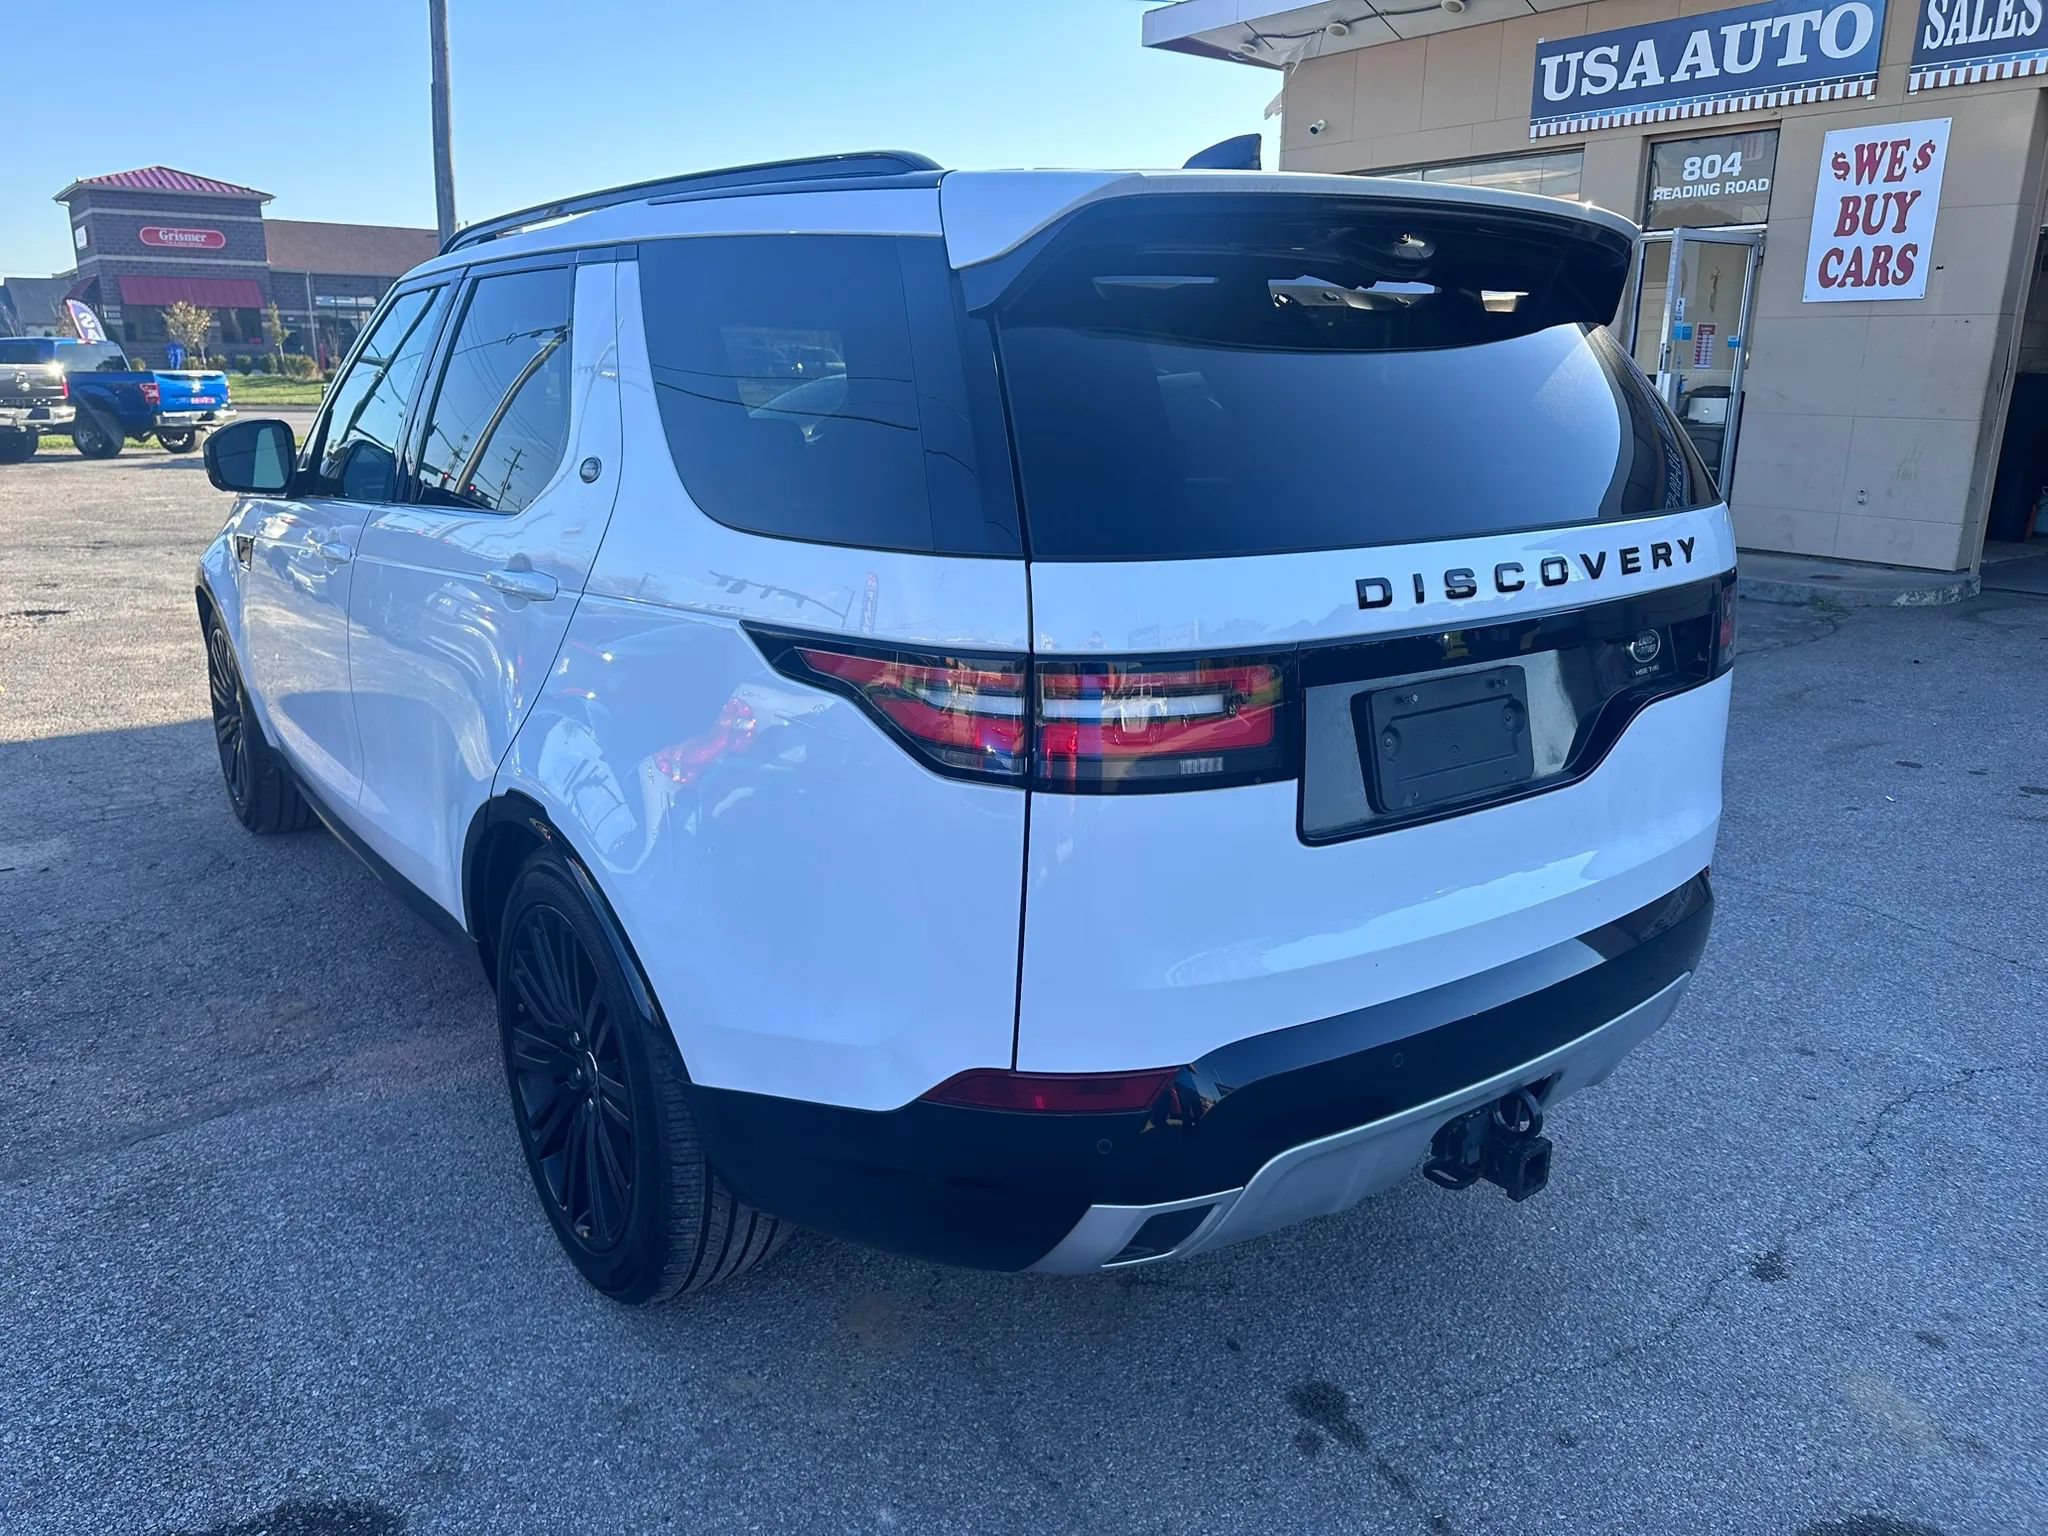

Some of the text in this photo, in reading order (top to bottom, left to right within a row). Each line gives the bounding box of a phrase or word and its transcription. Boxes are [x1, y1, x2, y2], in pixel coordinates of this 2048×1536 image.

[1922, 0, 2043, 49] SALES
[1540, 2, 1874, 102] USA AUTO
[1682, 151, 1742, 181] 804
[1653, 178, 1770, 201] READING ROAD
[159, 229, 207, 243] Grismer
[1833, 190, 1922, 237] BUY
[1818, 243, 1919, 289] CARS
[1354, 536, 1696, 610] DISCOVERY
